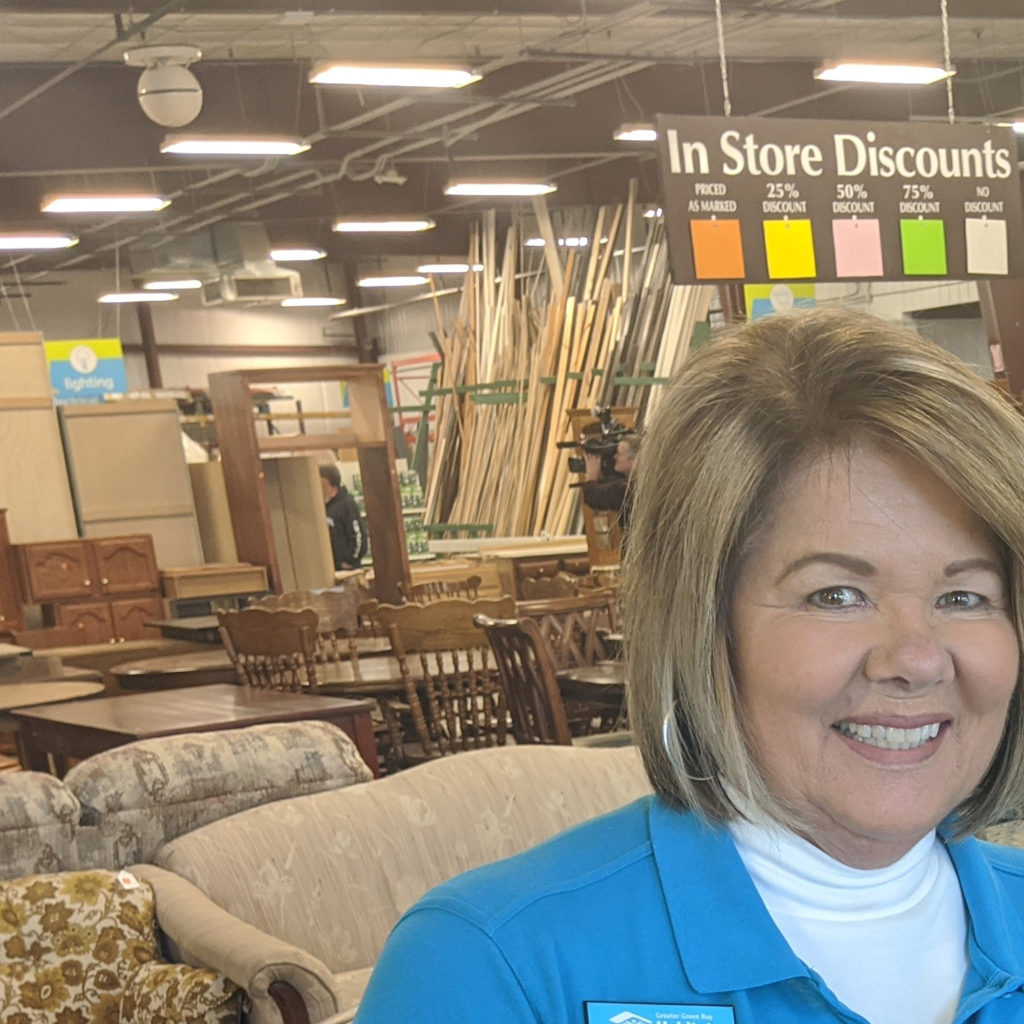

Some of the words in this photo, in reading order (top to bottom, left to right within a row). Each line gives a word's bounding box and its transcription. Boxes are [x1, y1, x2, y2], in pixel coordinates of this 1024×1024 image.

[667, 129, 709, 175] In
[720, 130, 823, 177] Store
[833, 131, 1012, 178] Discounts
[695, 183, 726, 196] PRICED
[767, 183, 799, 199] 25%
[836, 184, 868, 200] 50%
[903, 184, 934, 200] 75%
[976, 186, 990, 198] NO
[688, 200, 699, 212] AS
[701, 200, 737, 212] MARKED
[763, 201, 807, 213] DISCOUNT
[833, 201, 874, 213] DISCOUNT
[900, 202, 940, 213] DISCOUNT
[964, 202, 1004, 213] DISCOUNT
[64, 377, 115, 393] lighting
[655, 1012, 680, 1020] Greater
[701, 1013, 713, 1021] Bay
